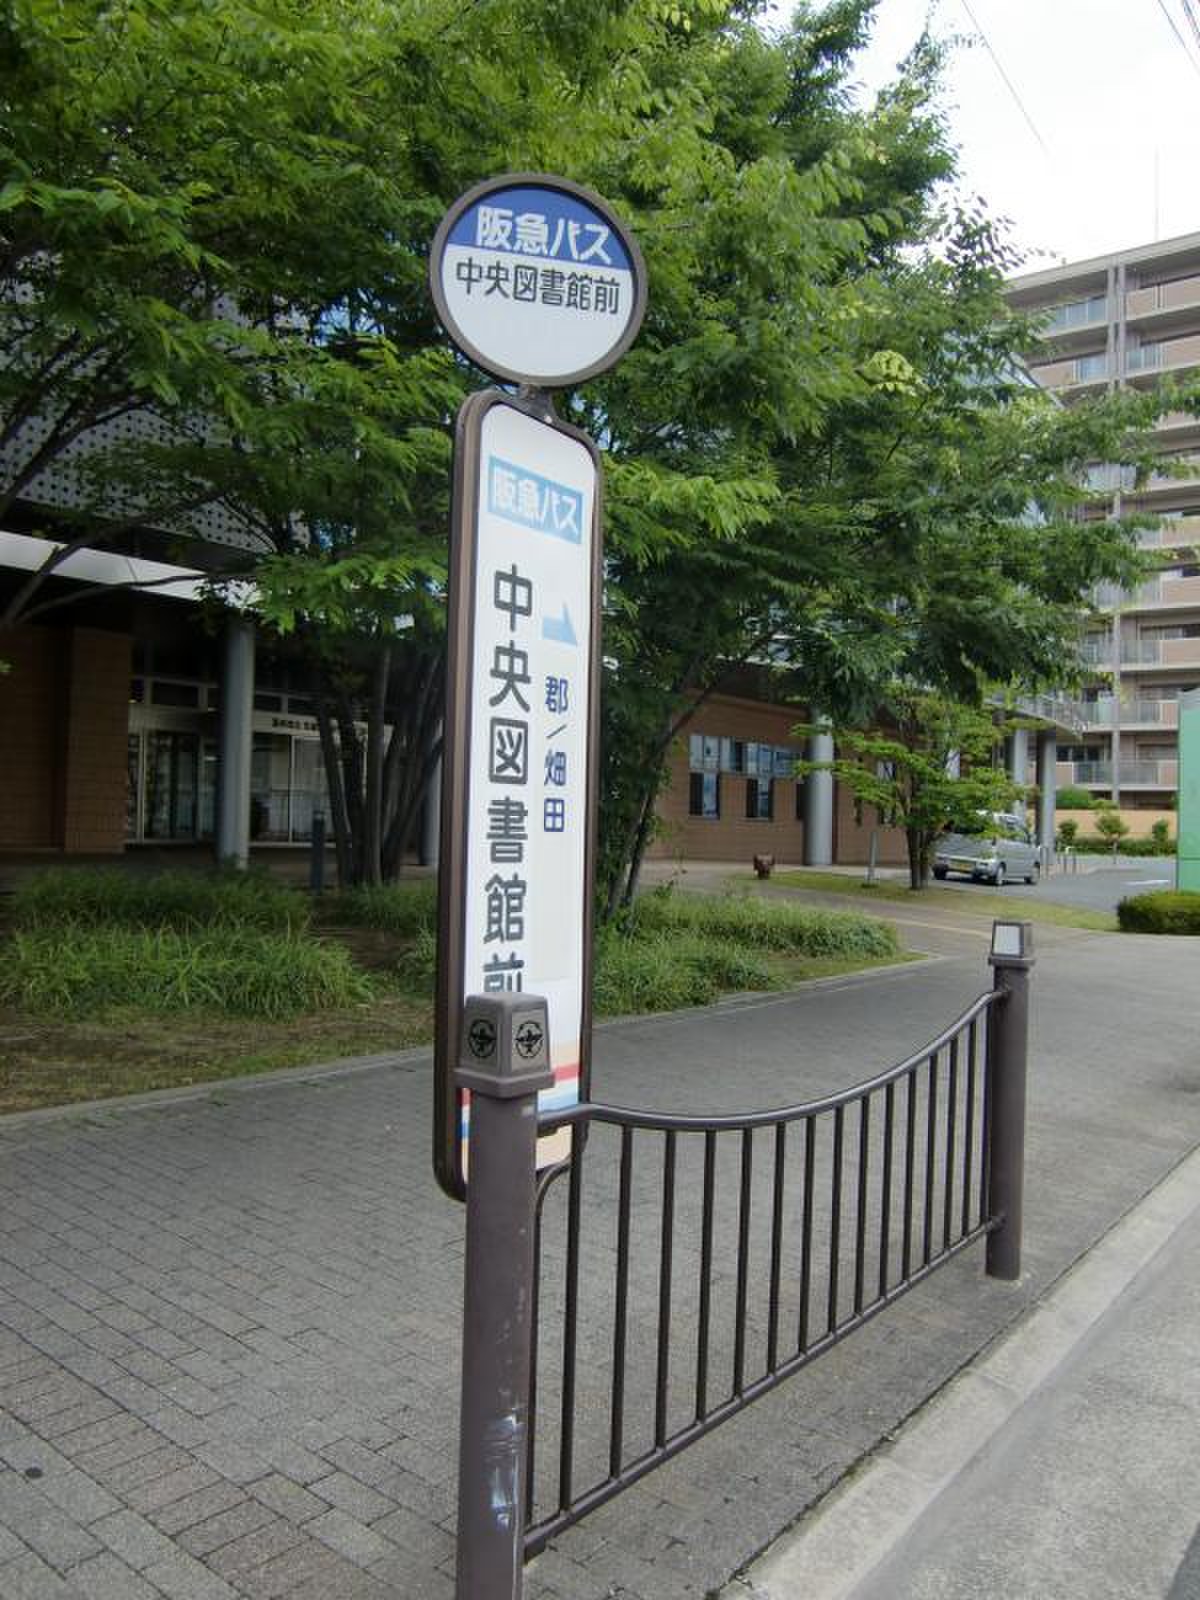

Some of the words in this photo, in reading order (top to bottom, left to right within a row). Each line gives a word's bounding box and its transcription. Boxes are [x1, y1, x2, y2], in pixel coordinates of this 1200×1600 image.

[475, 204, 612, 265] 阪急バス
[456, 257, 621, 315] 中央図書館前
[492, 464, 580, 537] 阪急バス
